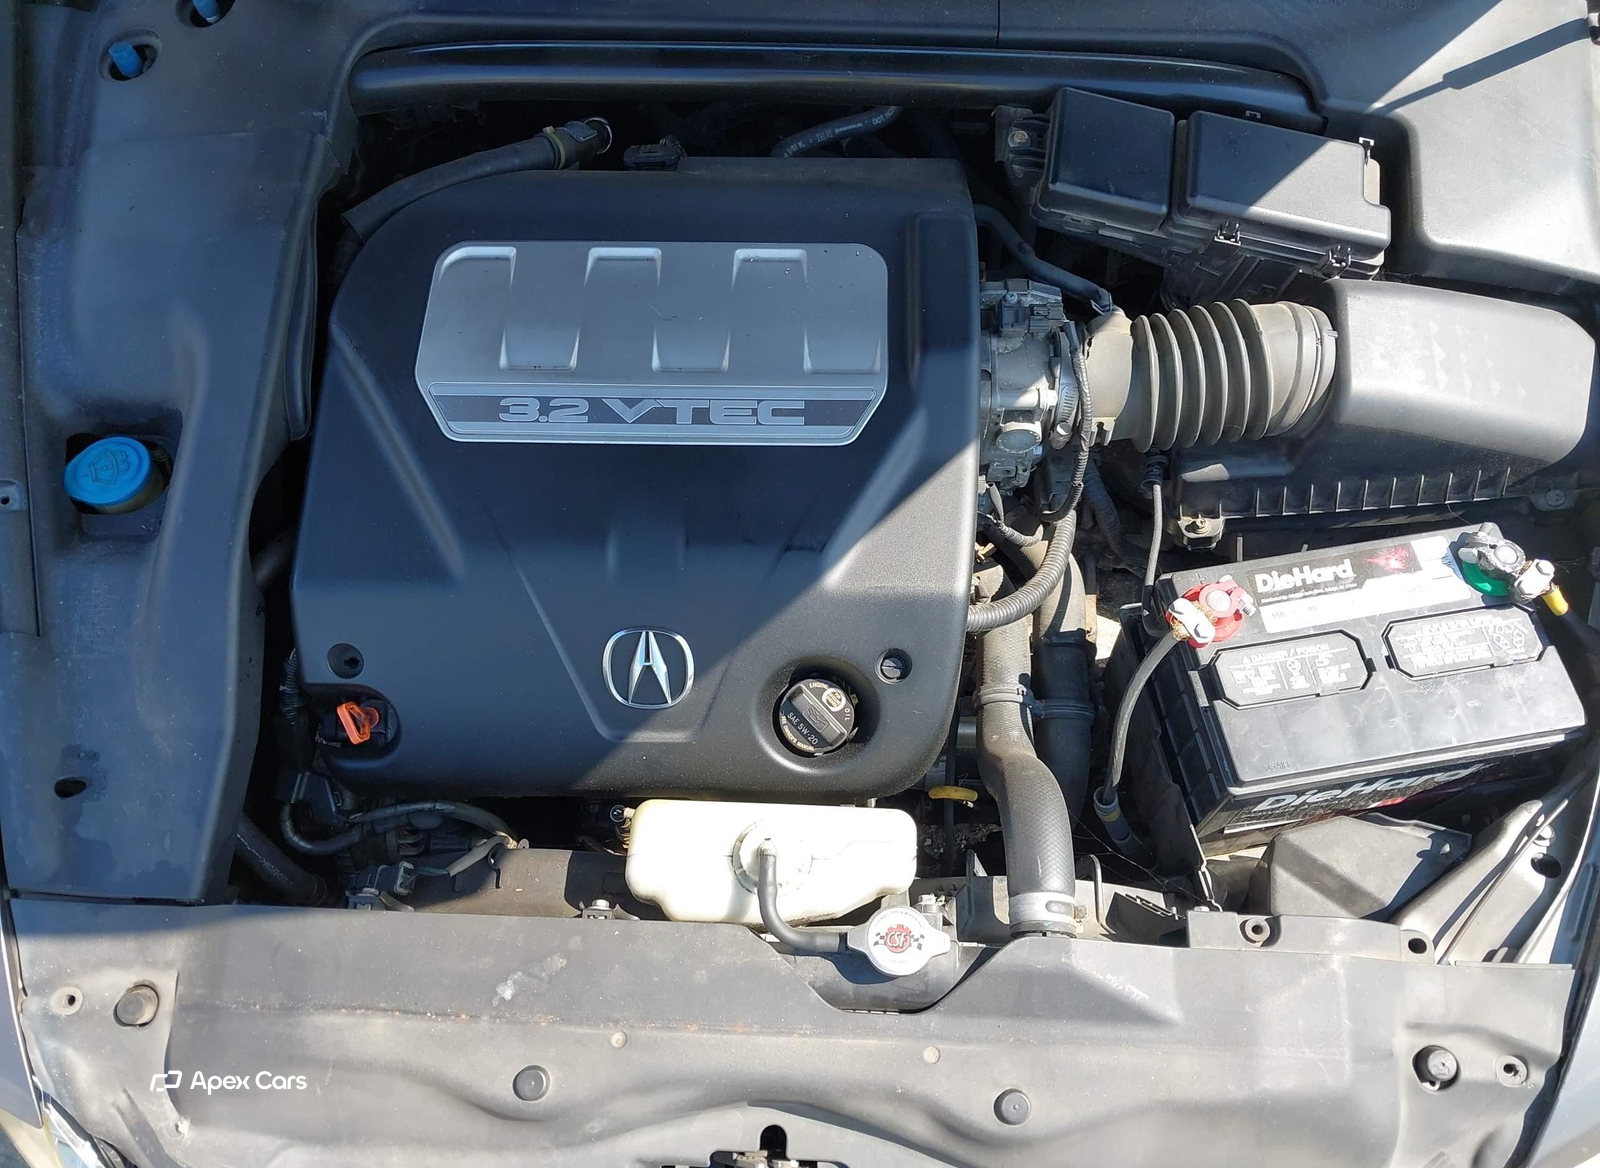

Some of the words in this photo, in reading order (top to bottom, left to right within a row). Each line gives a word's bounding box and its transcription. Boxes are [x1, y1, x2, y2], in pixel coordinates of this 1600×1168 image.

[498, 397, 589, 423] 3.2
[601, 398, 805, 425] VTEC
[1254, 559, 1354, 593] DieHard
[787, 712, 800, 727] SAE
[797, 723, 819, 745] 5W-20
[1252, 763, 1485, 812] DieHard
[887, 931, 907, 947] CSF
